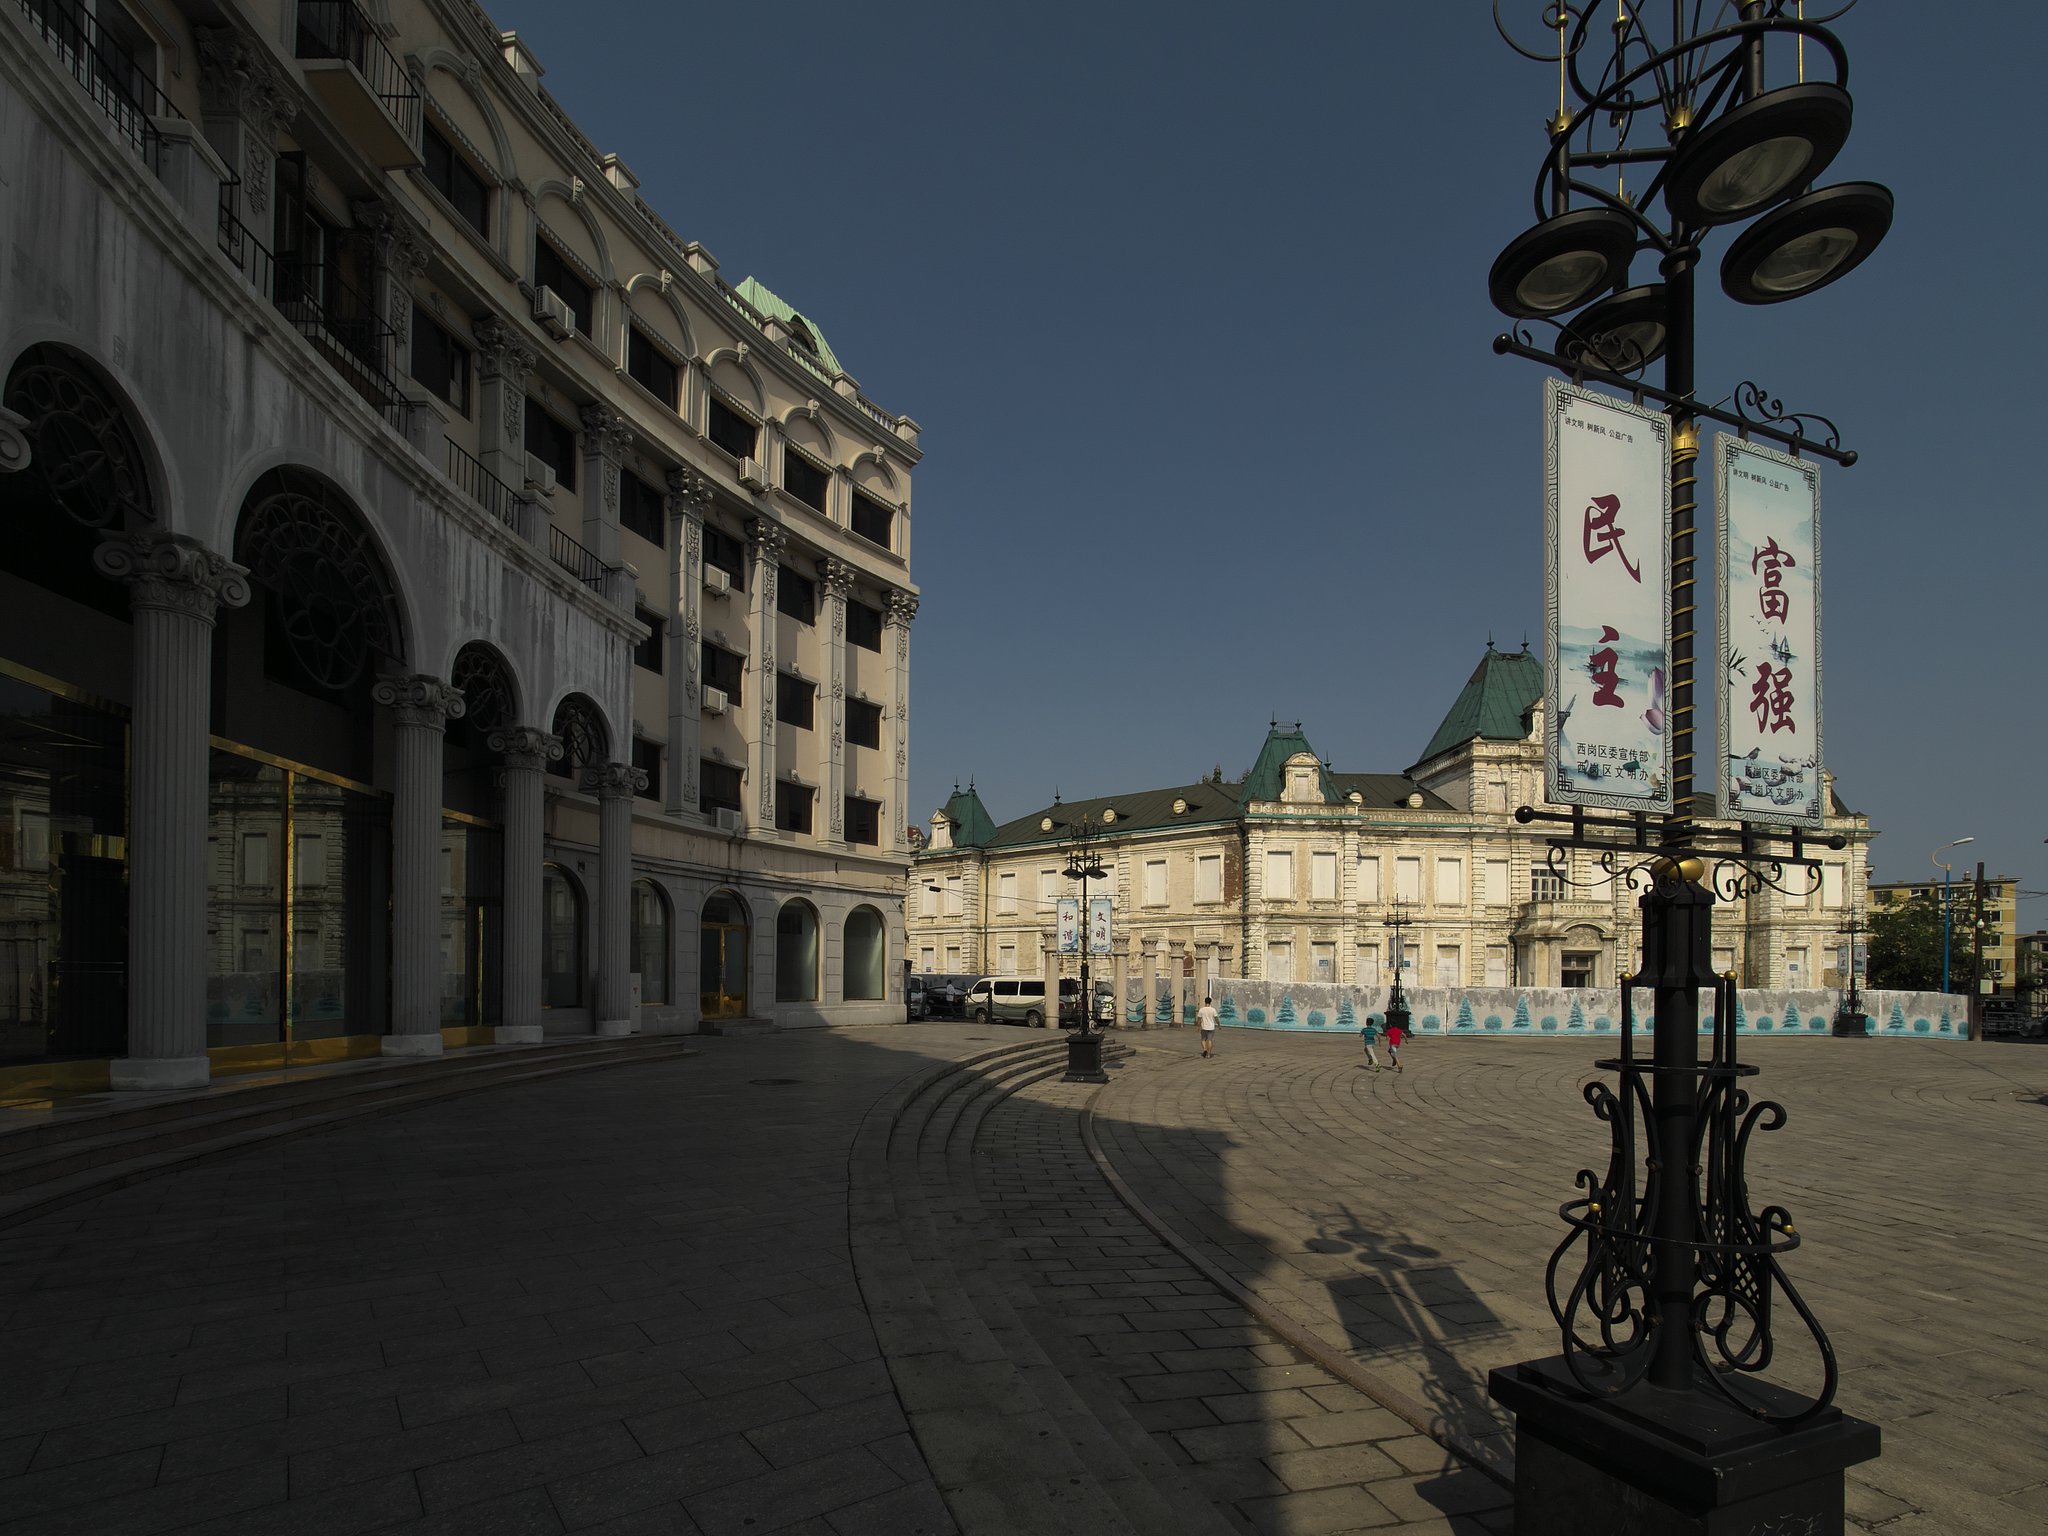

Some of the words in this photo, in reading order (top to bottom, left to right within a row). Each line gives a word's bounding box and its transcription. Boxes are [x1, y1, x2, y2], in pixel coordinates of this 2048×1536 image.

[1565, 416, 1584, 430] 讲文明
[1587, 423, 1606, 436] 树新风
[1609, 429, 1633, 444] 公益广告
[1769, 479, 1789, 492] 公益广告
[1583, 494, 1641, 708] 民主
[1750, 536, 1795, 734] 富强
[1576, 742, 1650, 763] 西岗区委宣传部
[1577, 760, 1648, 781] 西岗区文明办
[1095, 911, 1107, 941] 文明
